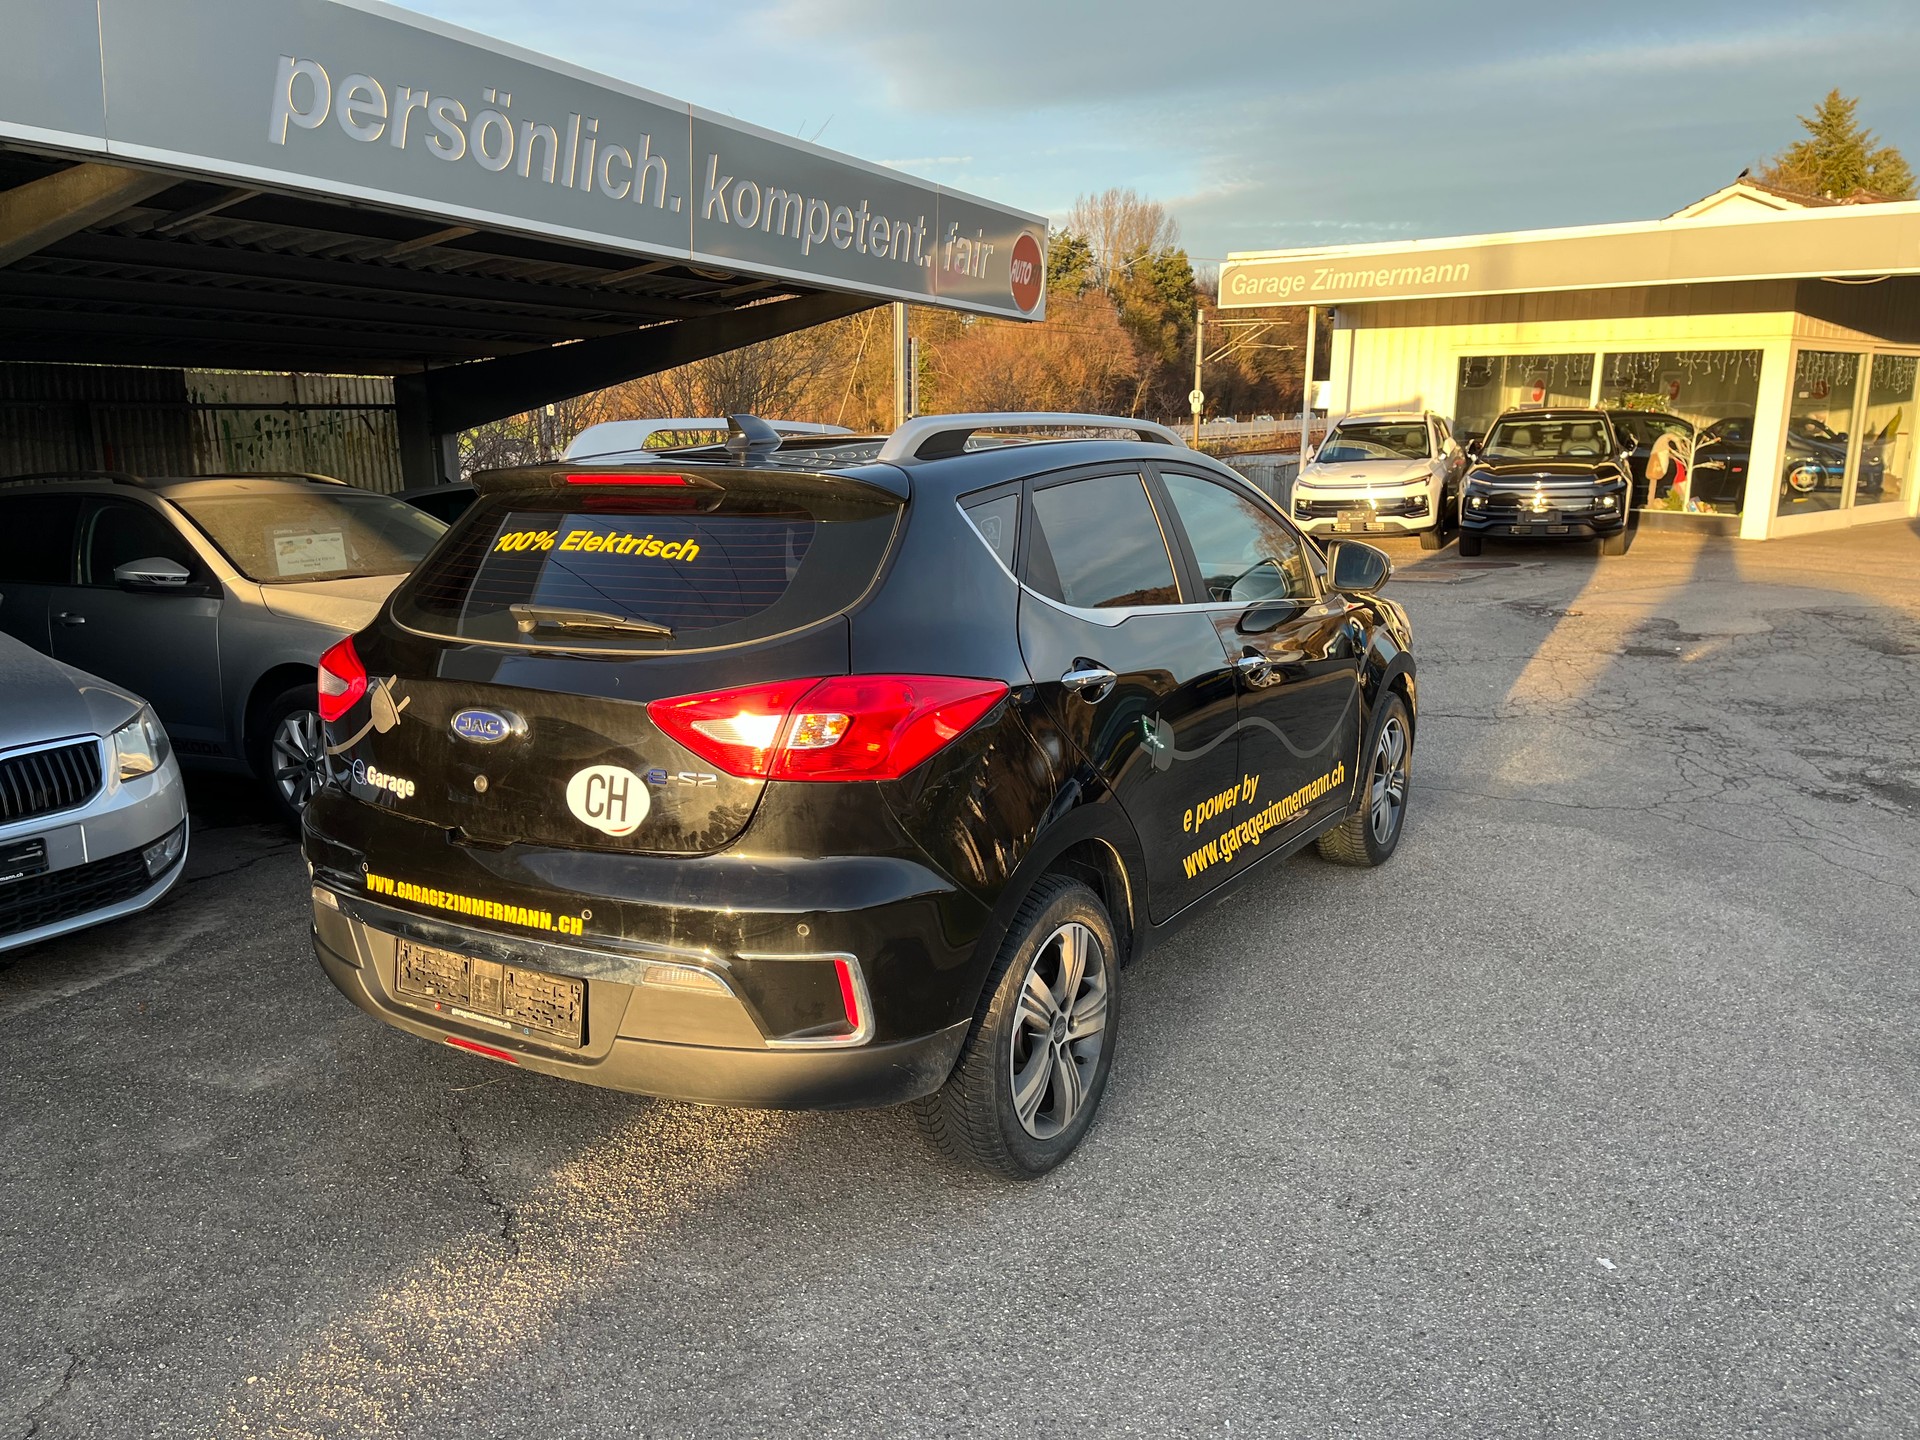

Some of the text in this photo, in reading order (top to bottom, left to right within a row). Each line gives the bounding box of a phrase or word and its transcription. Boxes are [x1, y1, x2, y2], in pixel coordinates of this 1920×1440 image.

[268, 53, 994, 279] persönlich. kompetent. fair
[1231, 263, 1470, 297] Garage Zimmermann
[1192, 391, 1201, 403] H
[493, 530, 700, 562] 100% Elektrisch
[460, 716, 500, 735] JAC
[585, 773, 629, 822] CH
[1183, 773, 1260, 833] e power by
[1183, 761, 1345, 879] www.garagezimmermann.ch
[366, 873, 583, 936] WWW.GARAGEZIMMERMANN.CH
